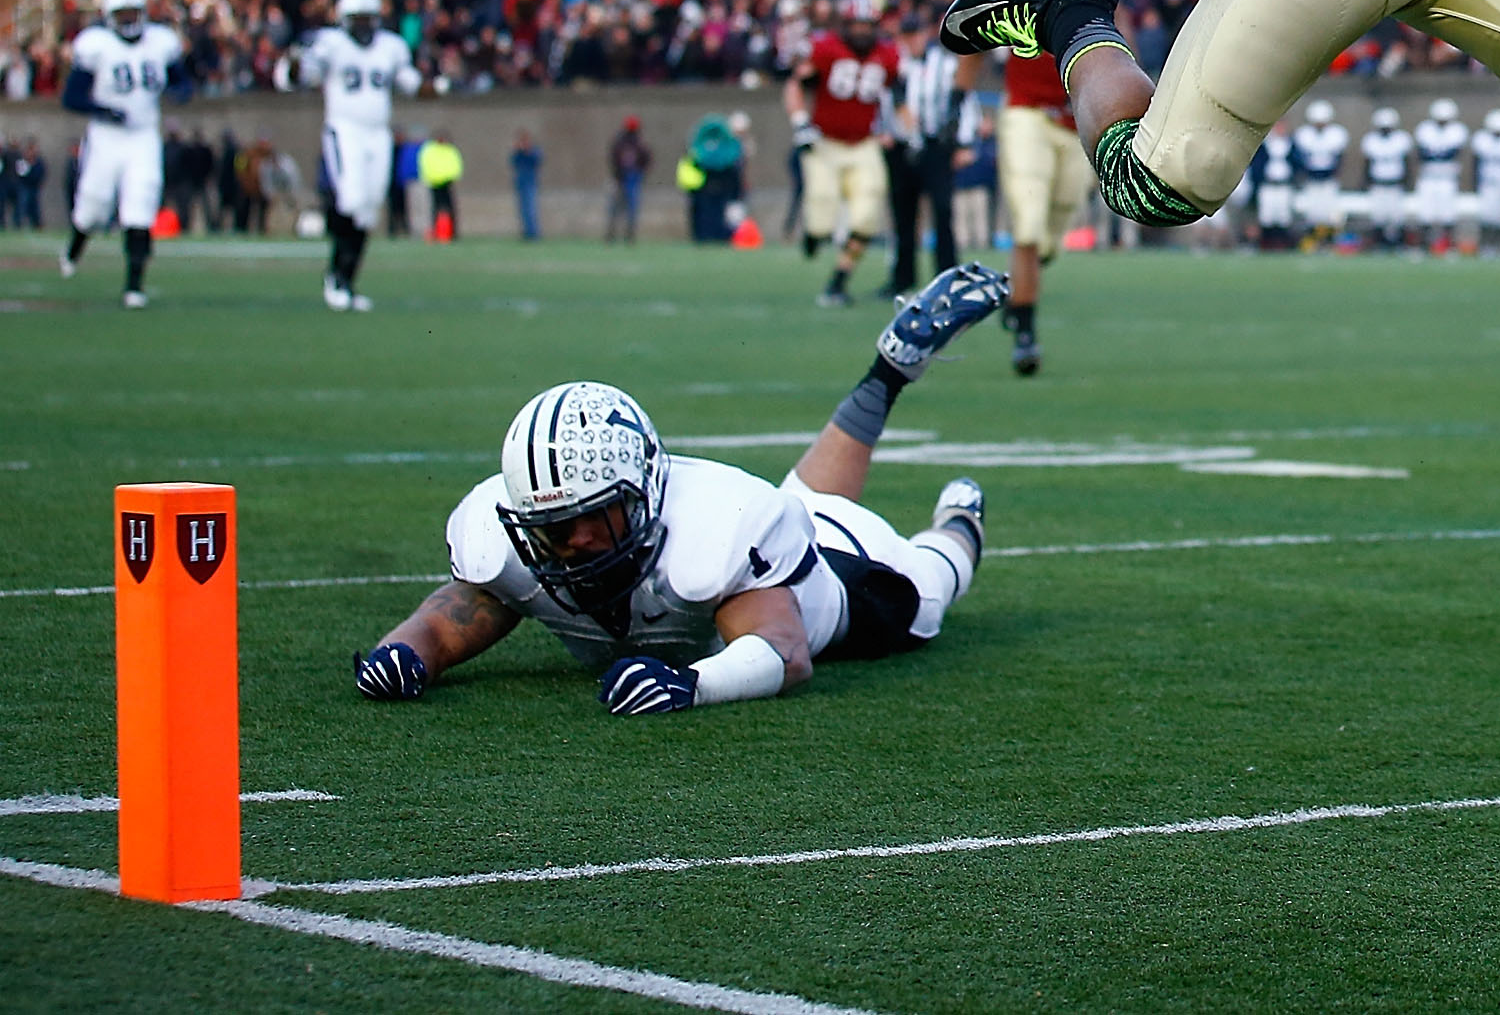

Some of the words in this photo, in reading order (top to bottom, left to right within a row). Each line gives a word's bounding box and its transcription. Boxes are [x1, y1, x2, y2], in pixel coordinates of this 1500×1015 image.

[533, 489, 564, 503] Riddell
[129, 519, 147, 562] H
[188, 520, 216, 563] H
